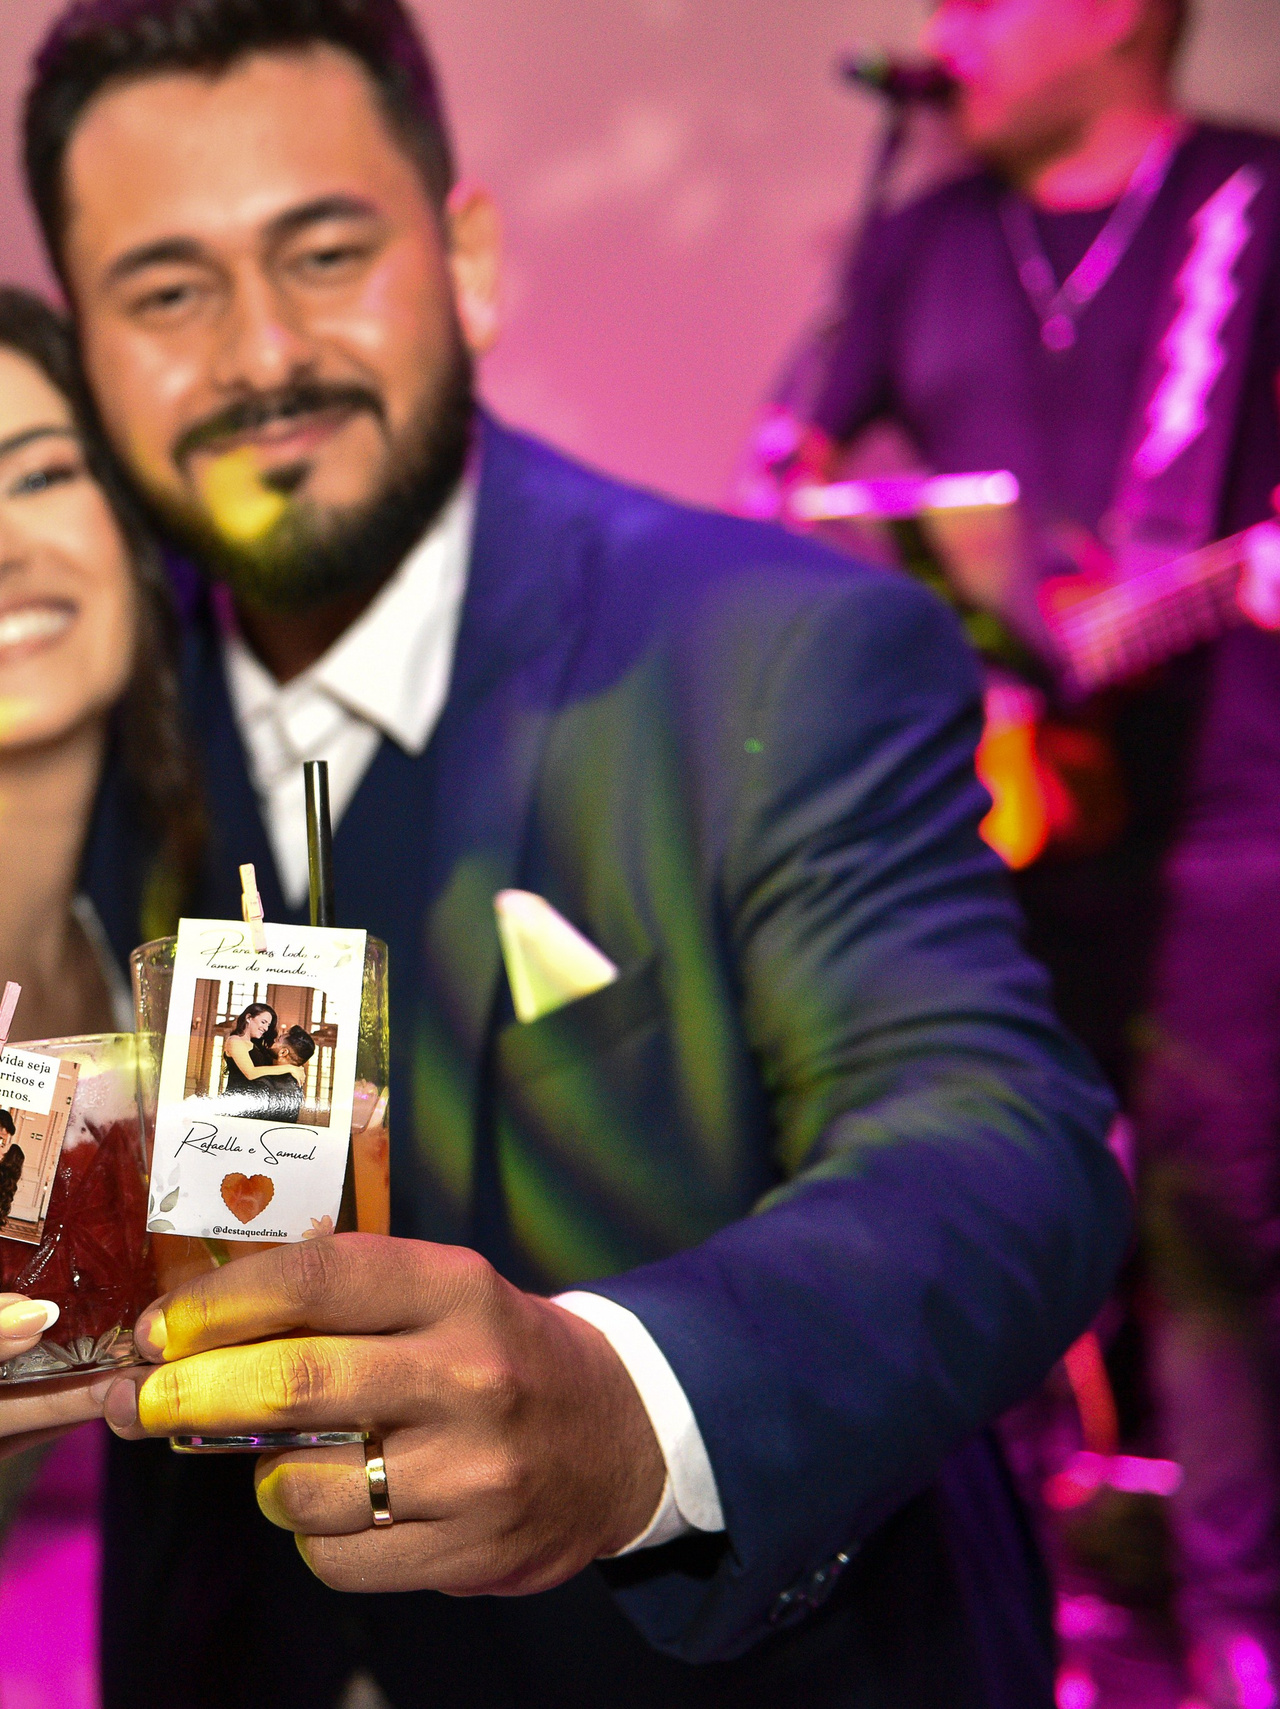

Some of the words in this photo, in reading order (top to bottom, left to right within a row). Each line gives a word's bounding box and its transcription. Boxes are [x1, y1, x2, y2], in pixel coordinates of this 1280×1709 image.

[200, 929, 251, 966] Para
[282, 944, 308, 959] todo
[245, 959, 260, 972] do
[0, 1054, 24, 1068] vida
[27, 1061, 51, 1074] seja
[38, 1080, 45, 1089] e
[174, 1121, 243, 1158] Rafaella
[248, 1146, 256, 1154] e
[260, 1126, 319, 1165] Samuel
[212, 1225, 288, 1238] @destaquedrinks
